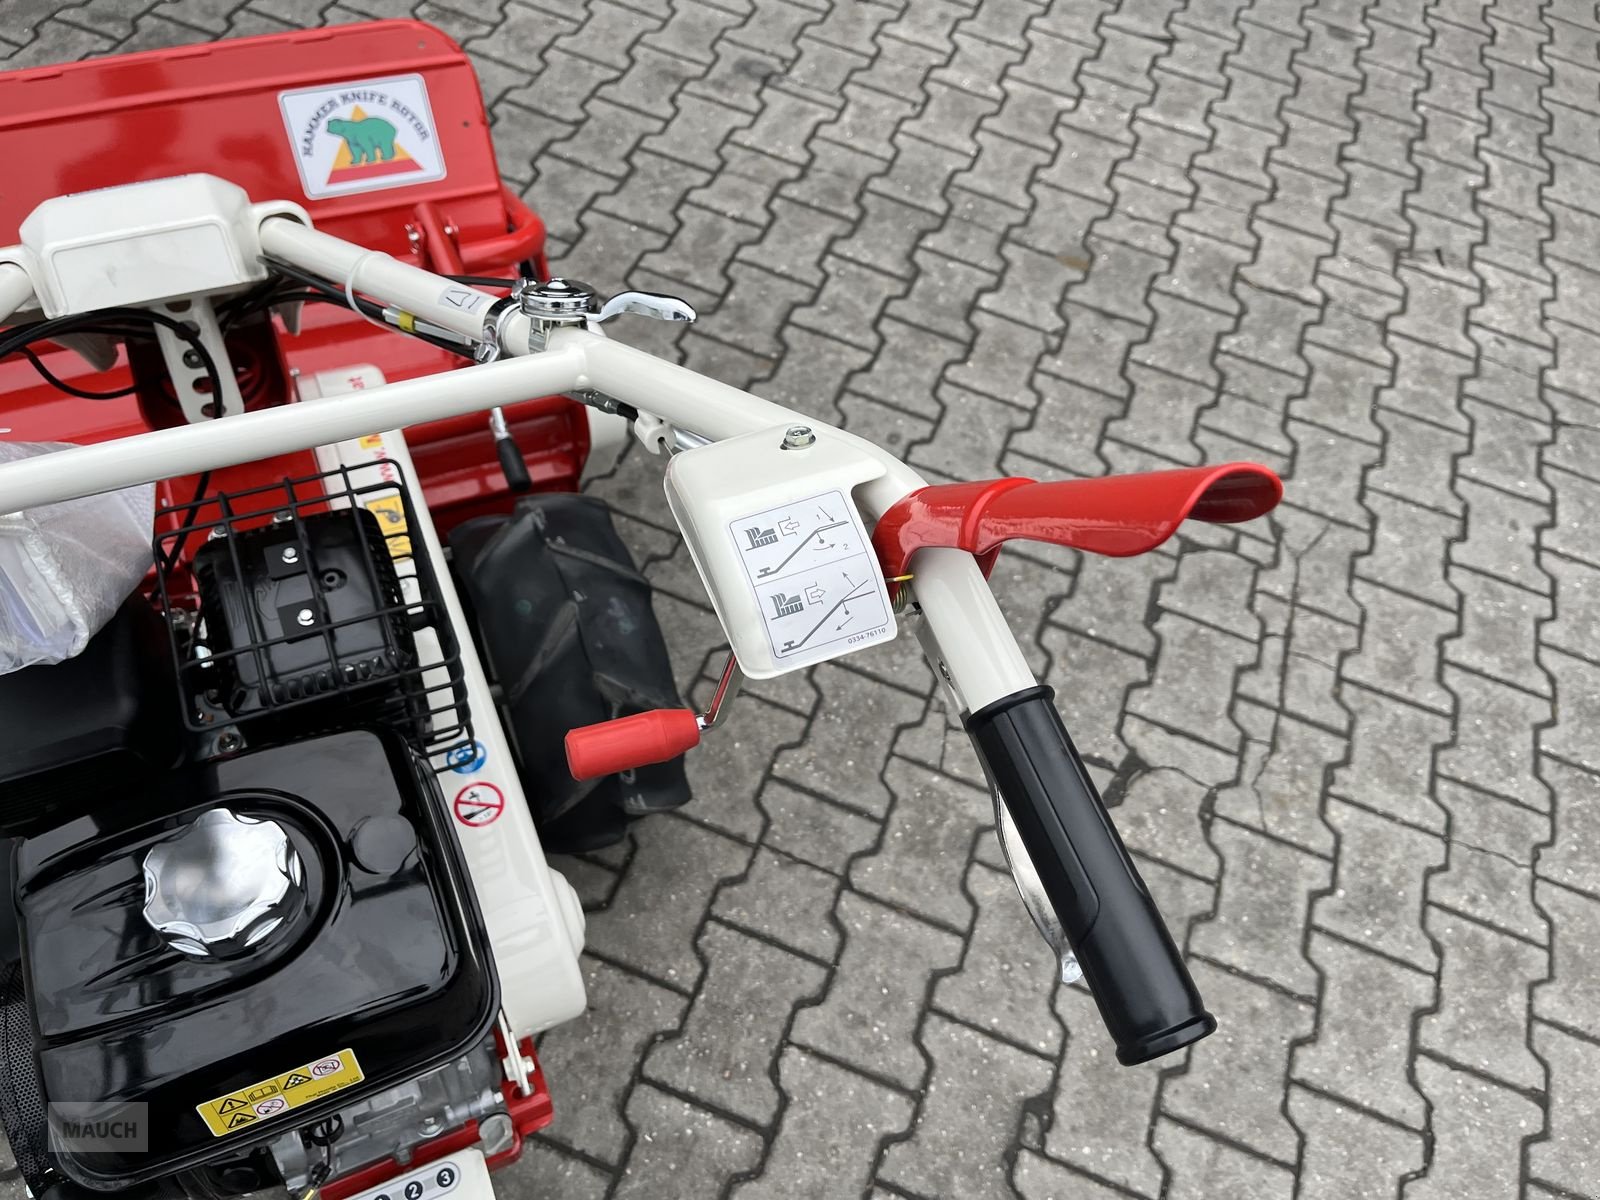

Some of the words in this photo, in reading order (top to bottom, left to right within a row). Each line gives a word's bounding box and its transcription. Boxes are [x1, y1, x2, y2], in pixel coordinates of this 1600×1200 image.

[303, 97, 339, 156] HAMMER
[340, 91, 388, 104] KNIFE
[391, 99, 430, 141] ROTOR
[848, 628, 886, 644] 0334-76110
[409, 1184, 420, 1198] 2
[440, 1171, 451, 1185] 3
